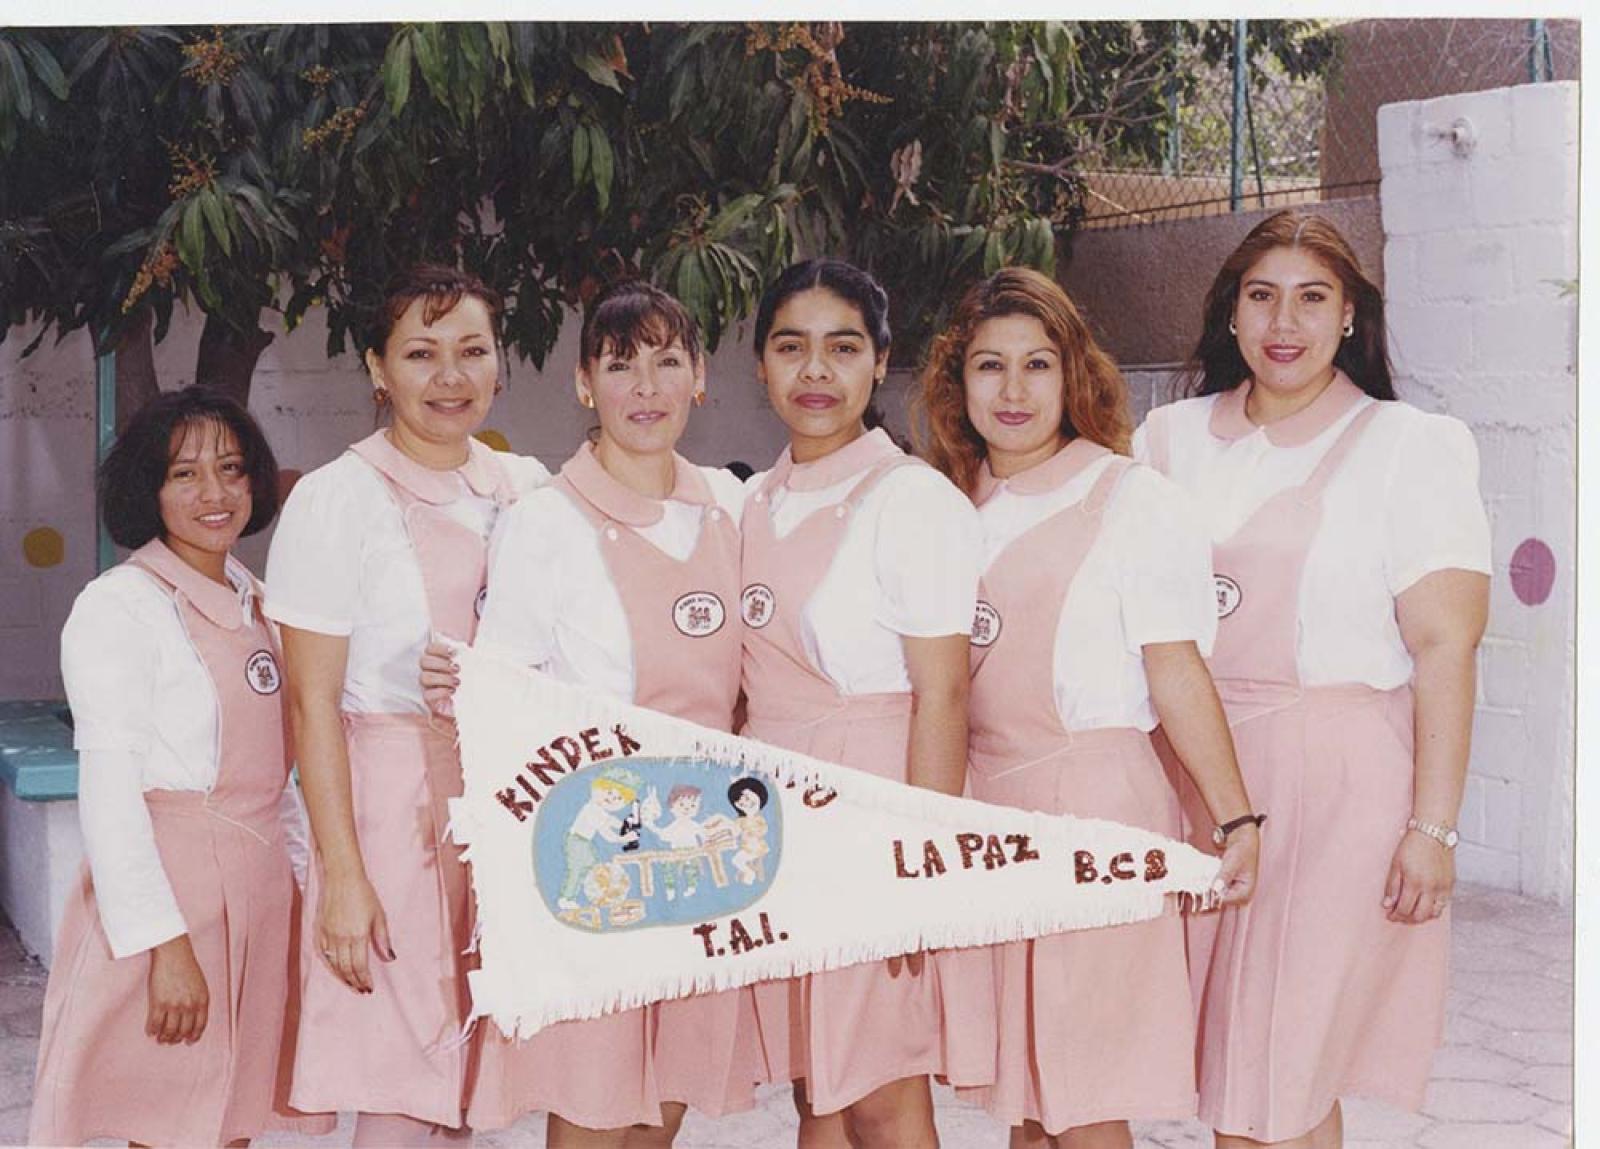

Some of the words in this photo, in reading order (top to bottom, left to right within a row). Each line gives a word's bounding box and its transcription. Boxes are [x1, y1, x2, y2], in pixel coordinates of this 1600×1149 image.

[893, 839, 947, 878] LA
[955, 832, 1040, 870] PAZ
[692, 912, 788, 957] T.A.I.
